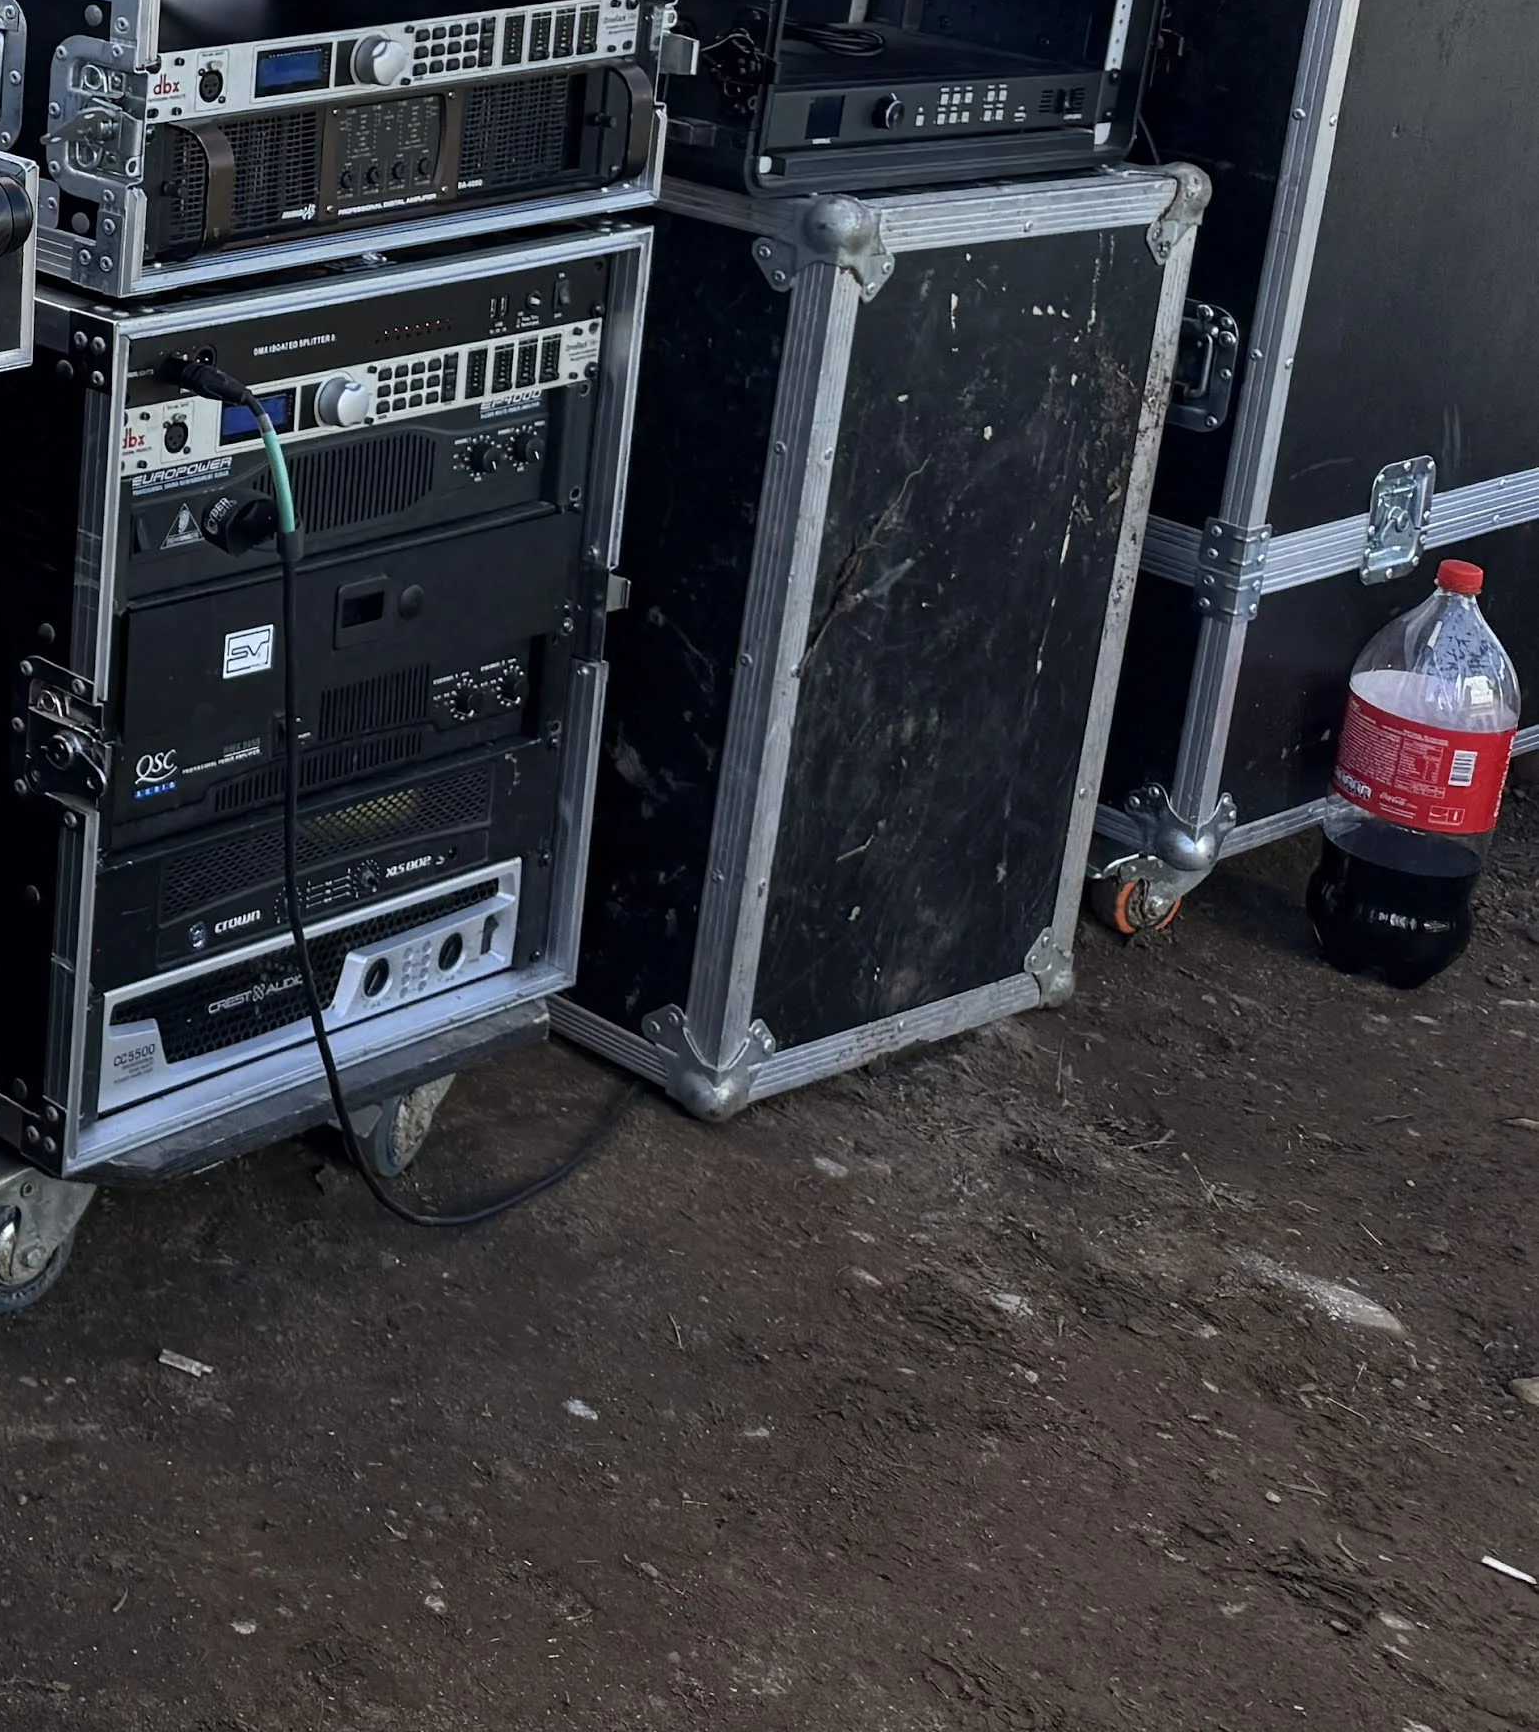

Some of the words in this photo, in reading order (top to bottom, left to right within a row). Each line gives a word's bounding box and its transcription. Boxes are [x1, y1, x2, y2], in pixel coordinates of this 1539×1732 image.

[153, 74, 180, 95] dbx
[122, 428, 145, 449] dbx
[131, 456, 233, 487] EUROPOWER
[135, 749, 178, 784] QSC
[214, 909, 261, 934] crown
[208, 990, 252, 1015] CREST
